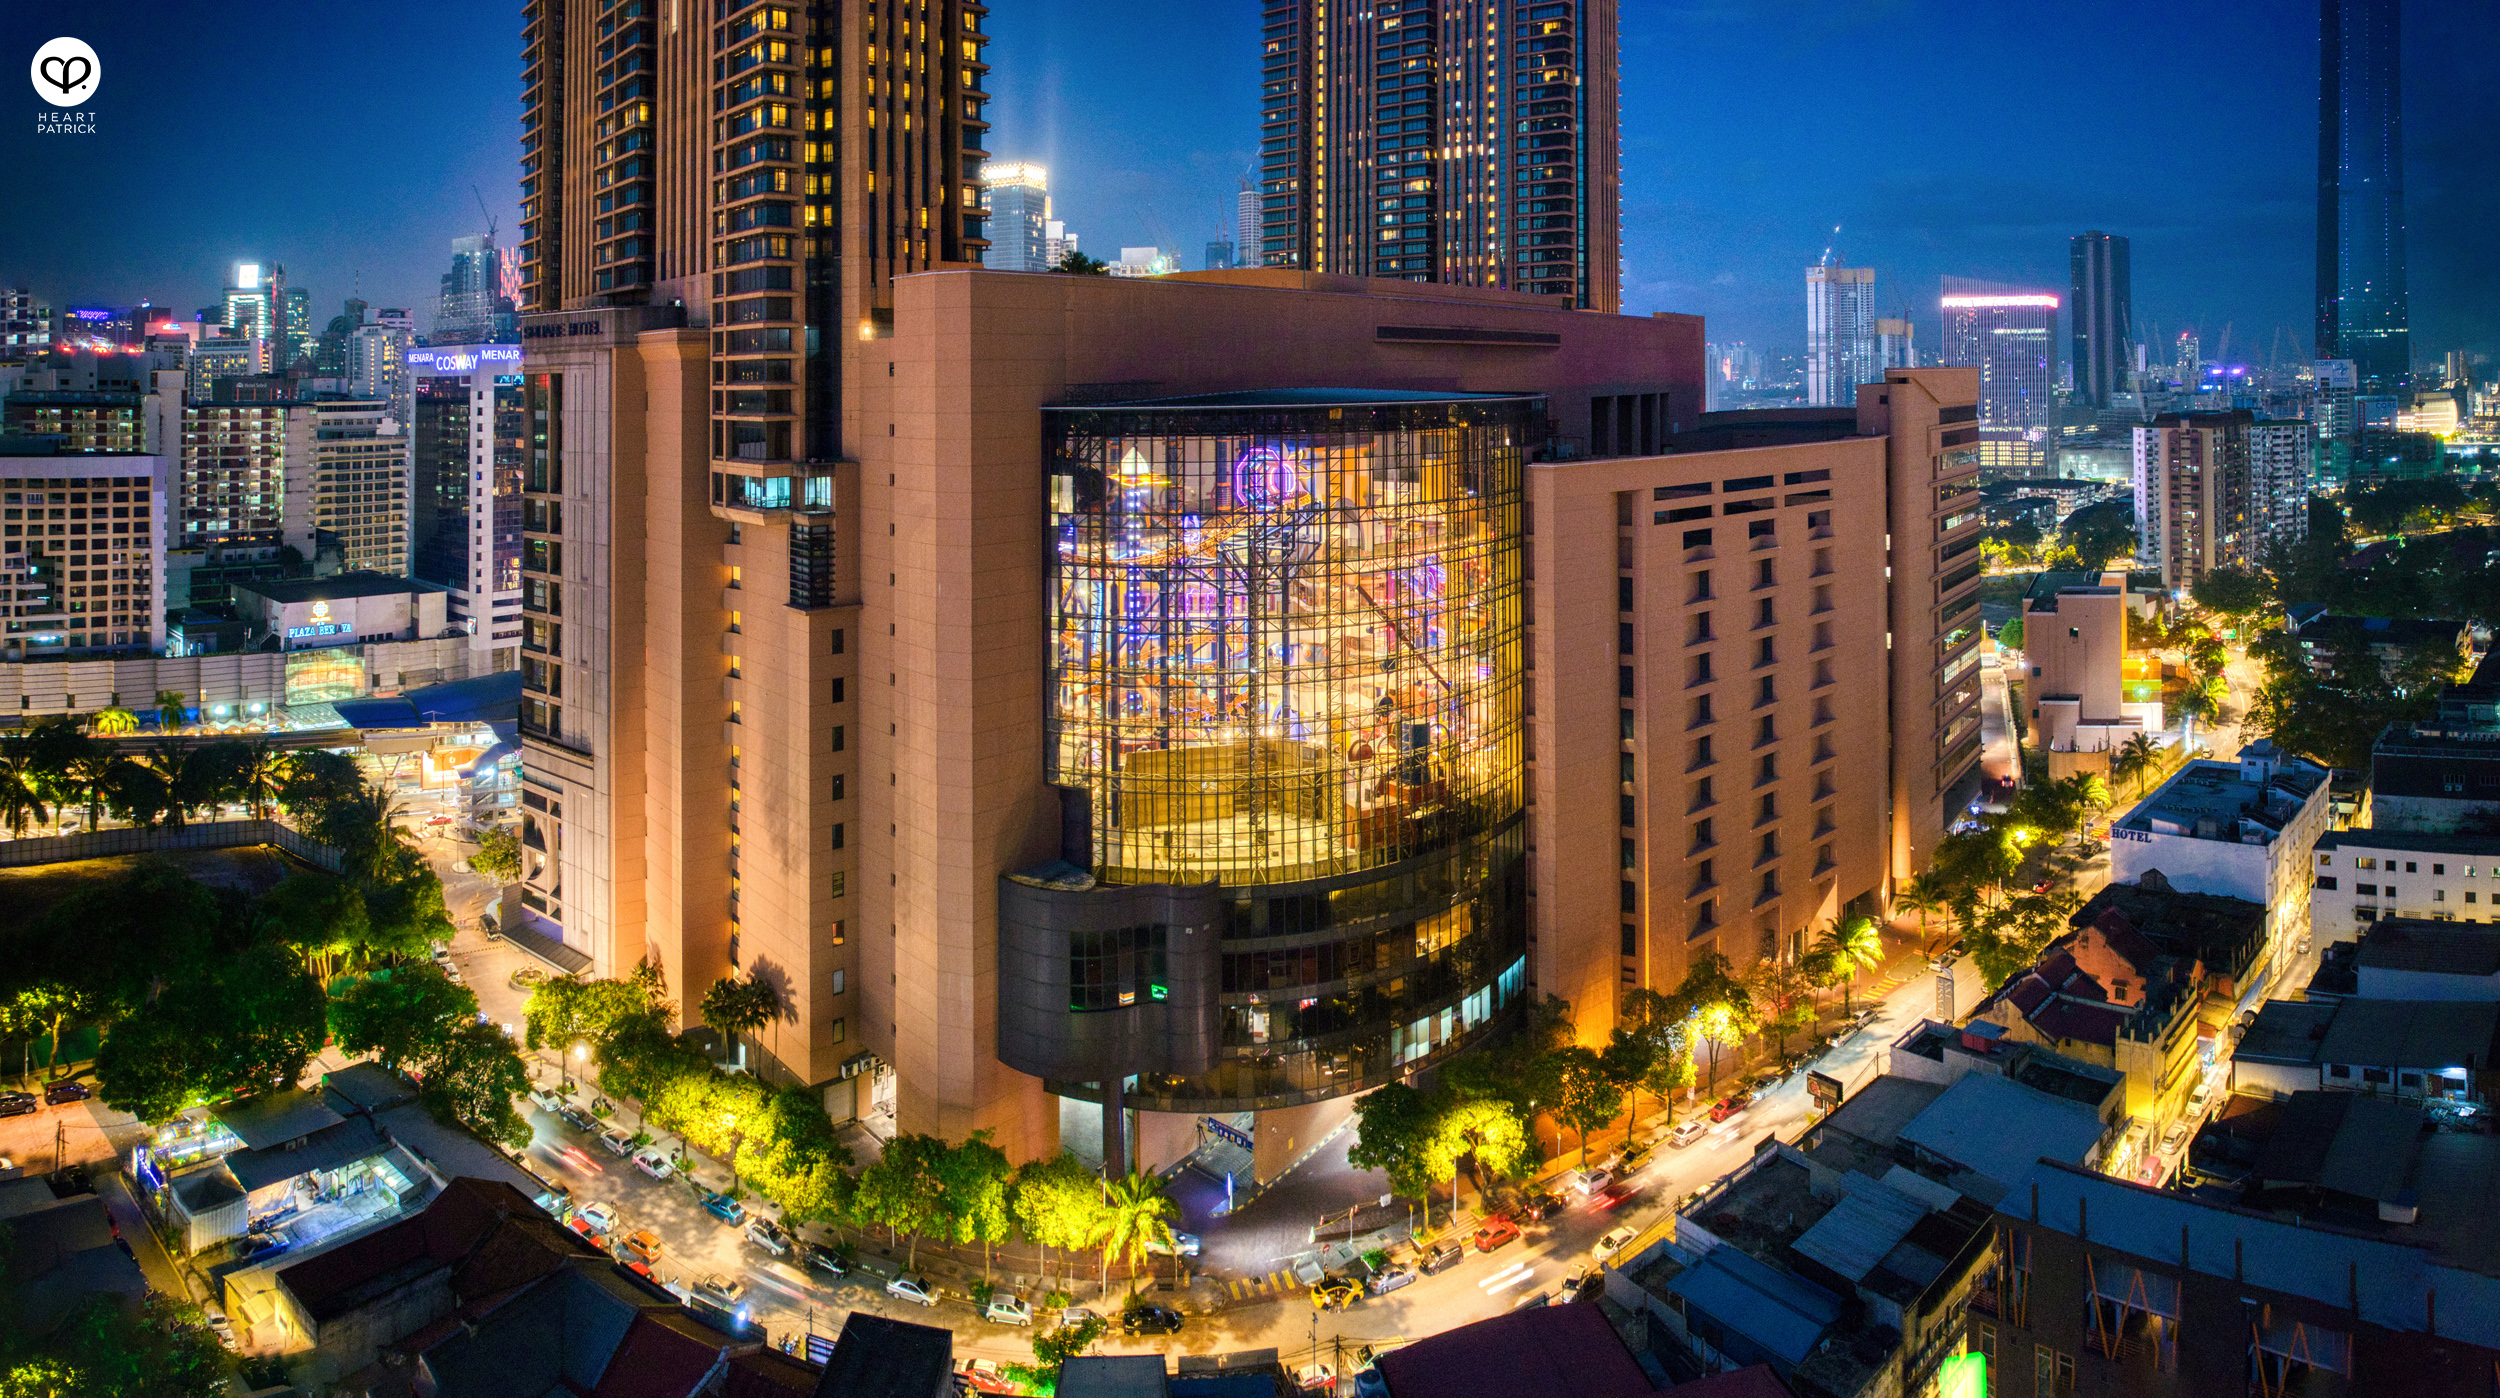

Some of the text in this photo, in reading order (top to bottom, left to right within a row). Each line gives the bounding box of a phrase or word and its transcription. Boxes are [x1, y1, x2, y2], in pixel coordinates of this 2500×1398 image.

[408, 352, 479, 371] MENARA COSWAY
[481, 349, 520, 360] MENAR
[288, 626, 316, 639] PLAZA
[2111, 828, 2152, 843] HOTEL
